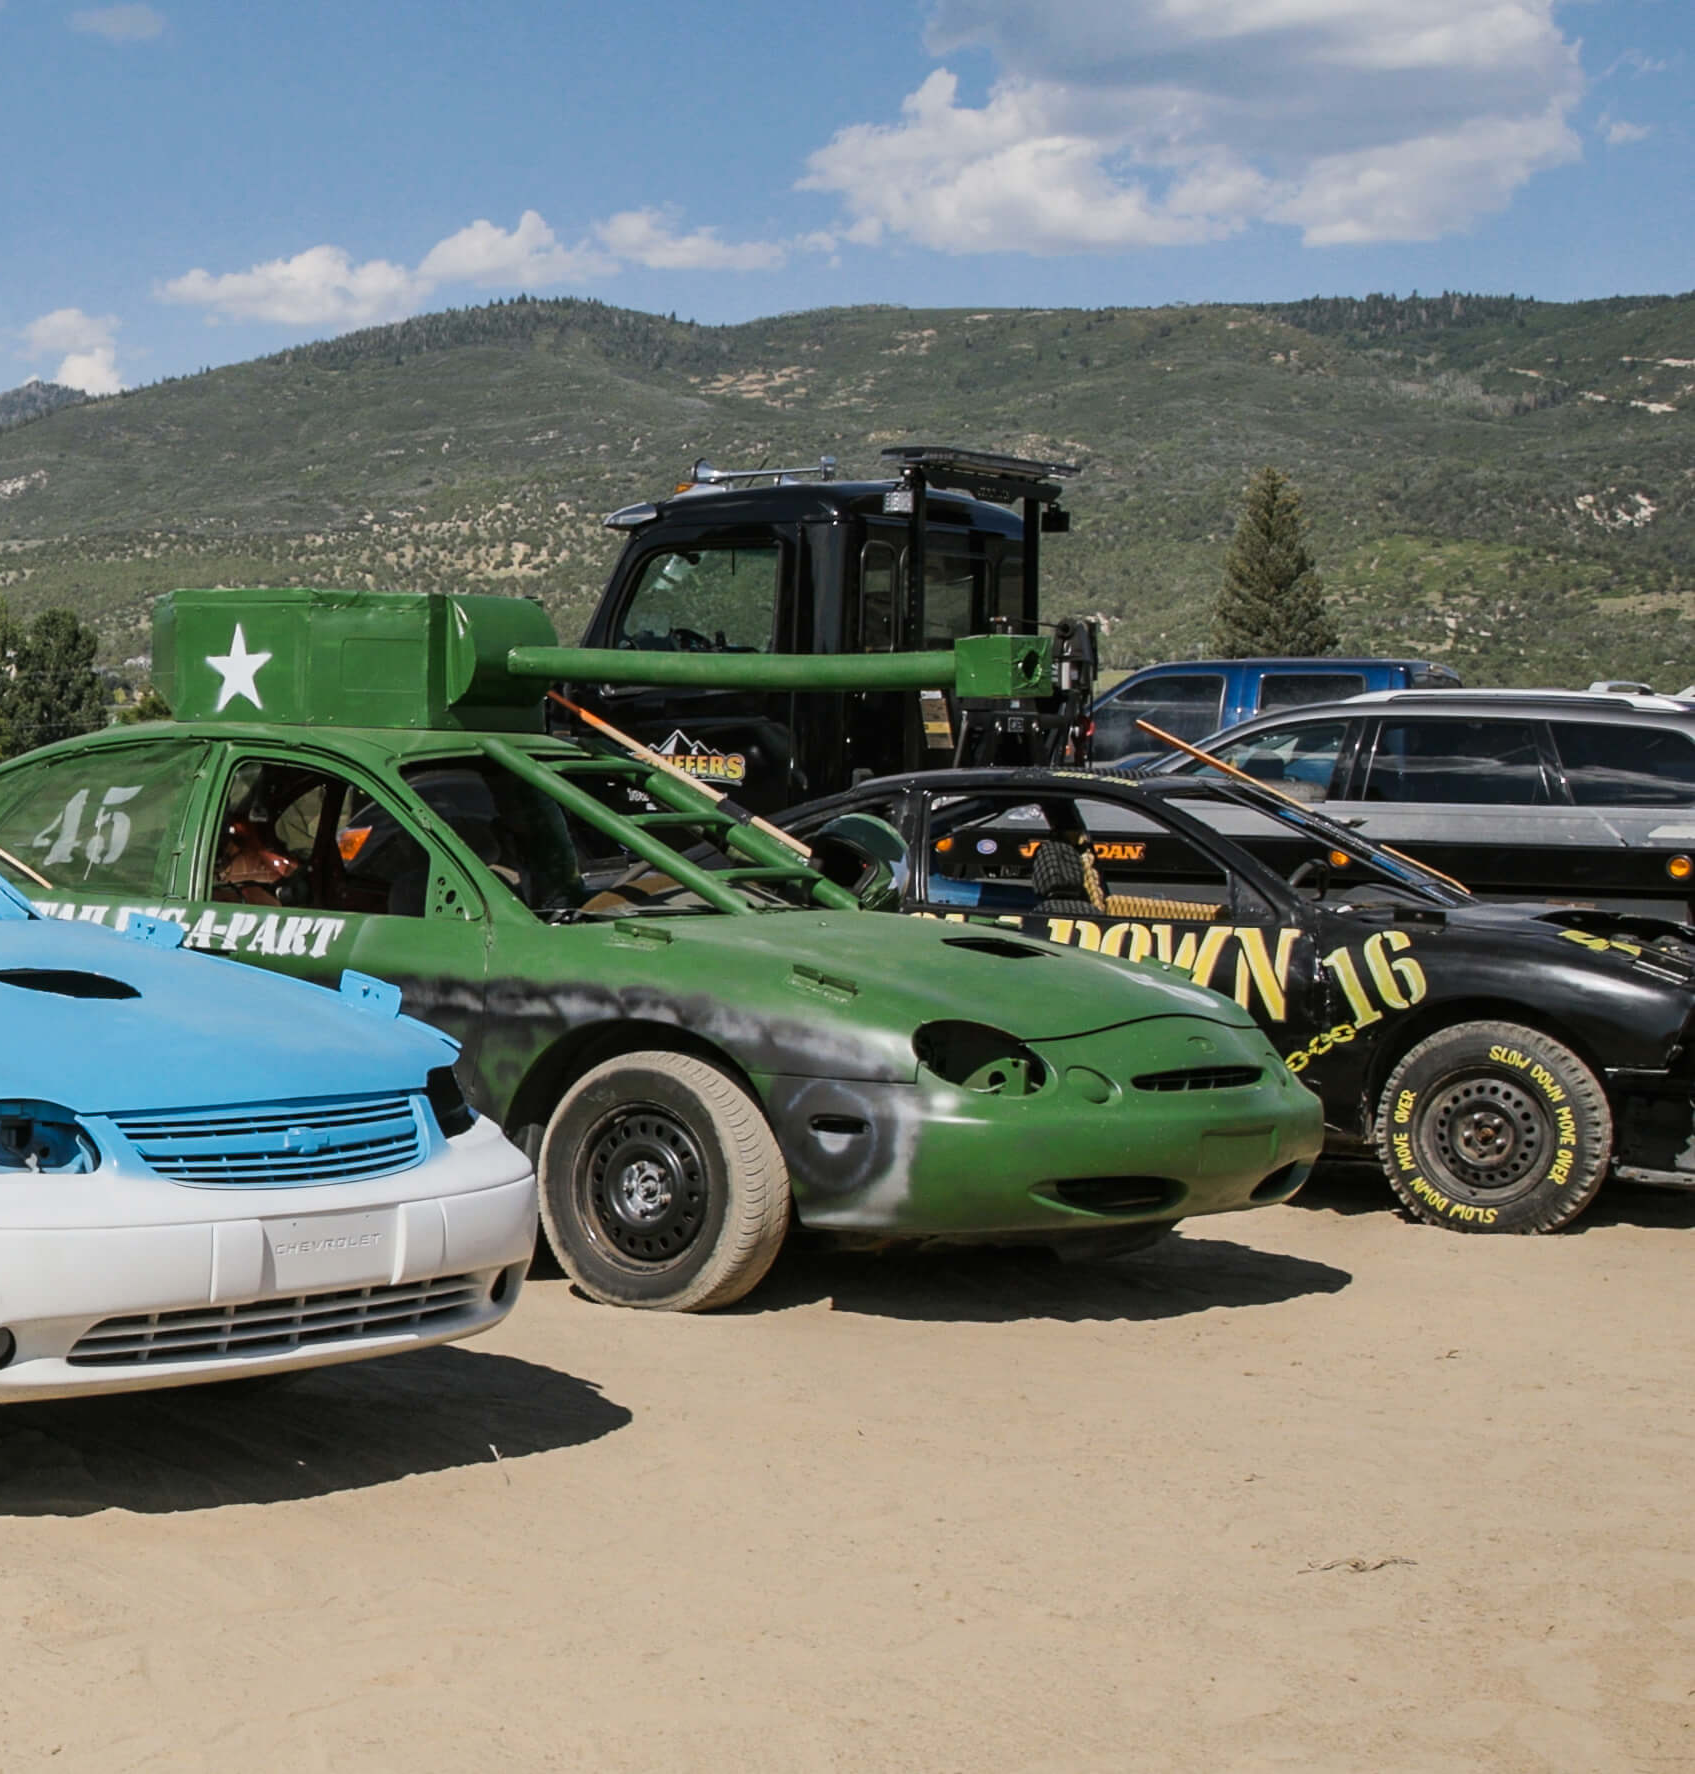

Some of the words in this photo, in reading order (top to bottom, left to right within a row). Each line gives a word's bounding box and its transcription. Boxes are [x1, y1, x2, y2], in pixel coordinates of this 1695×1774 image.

[22, 785, 144, 870] 45
[1047, 918, 1302, 1021] WN
[1322, 930, 1427, 1030] 16
[1489, 1045, 1532, 1070] SLOW
[1529, 1063, 1567, 1103] DOWN
[1394, 1089, 1418, 1124] OVER
[1555, 1106, 1577, 1146] MOVE
[1393, 1132, 1417, 1172] MOVE
[1547, 1149, 1574, 1186] OVER
[1409, 1176, 1450, 1212] DOWN
[1449, 1203, 1499, 1224] SLOW
[274, 1231, 383, 1256] CHEVROLET
